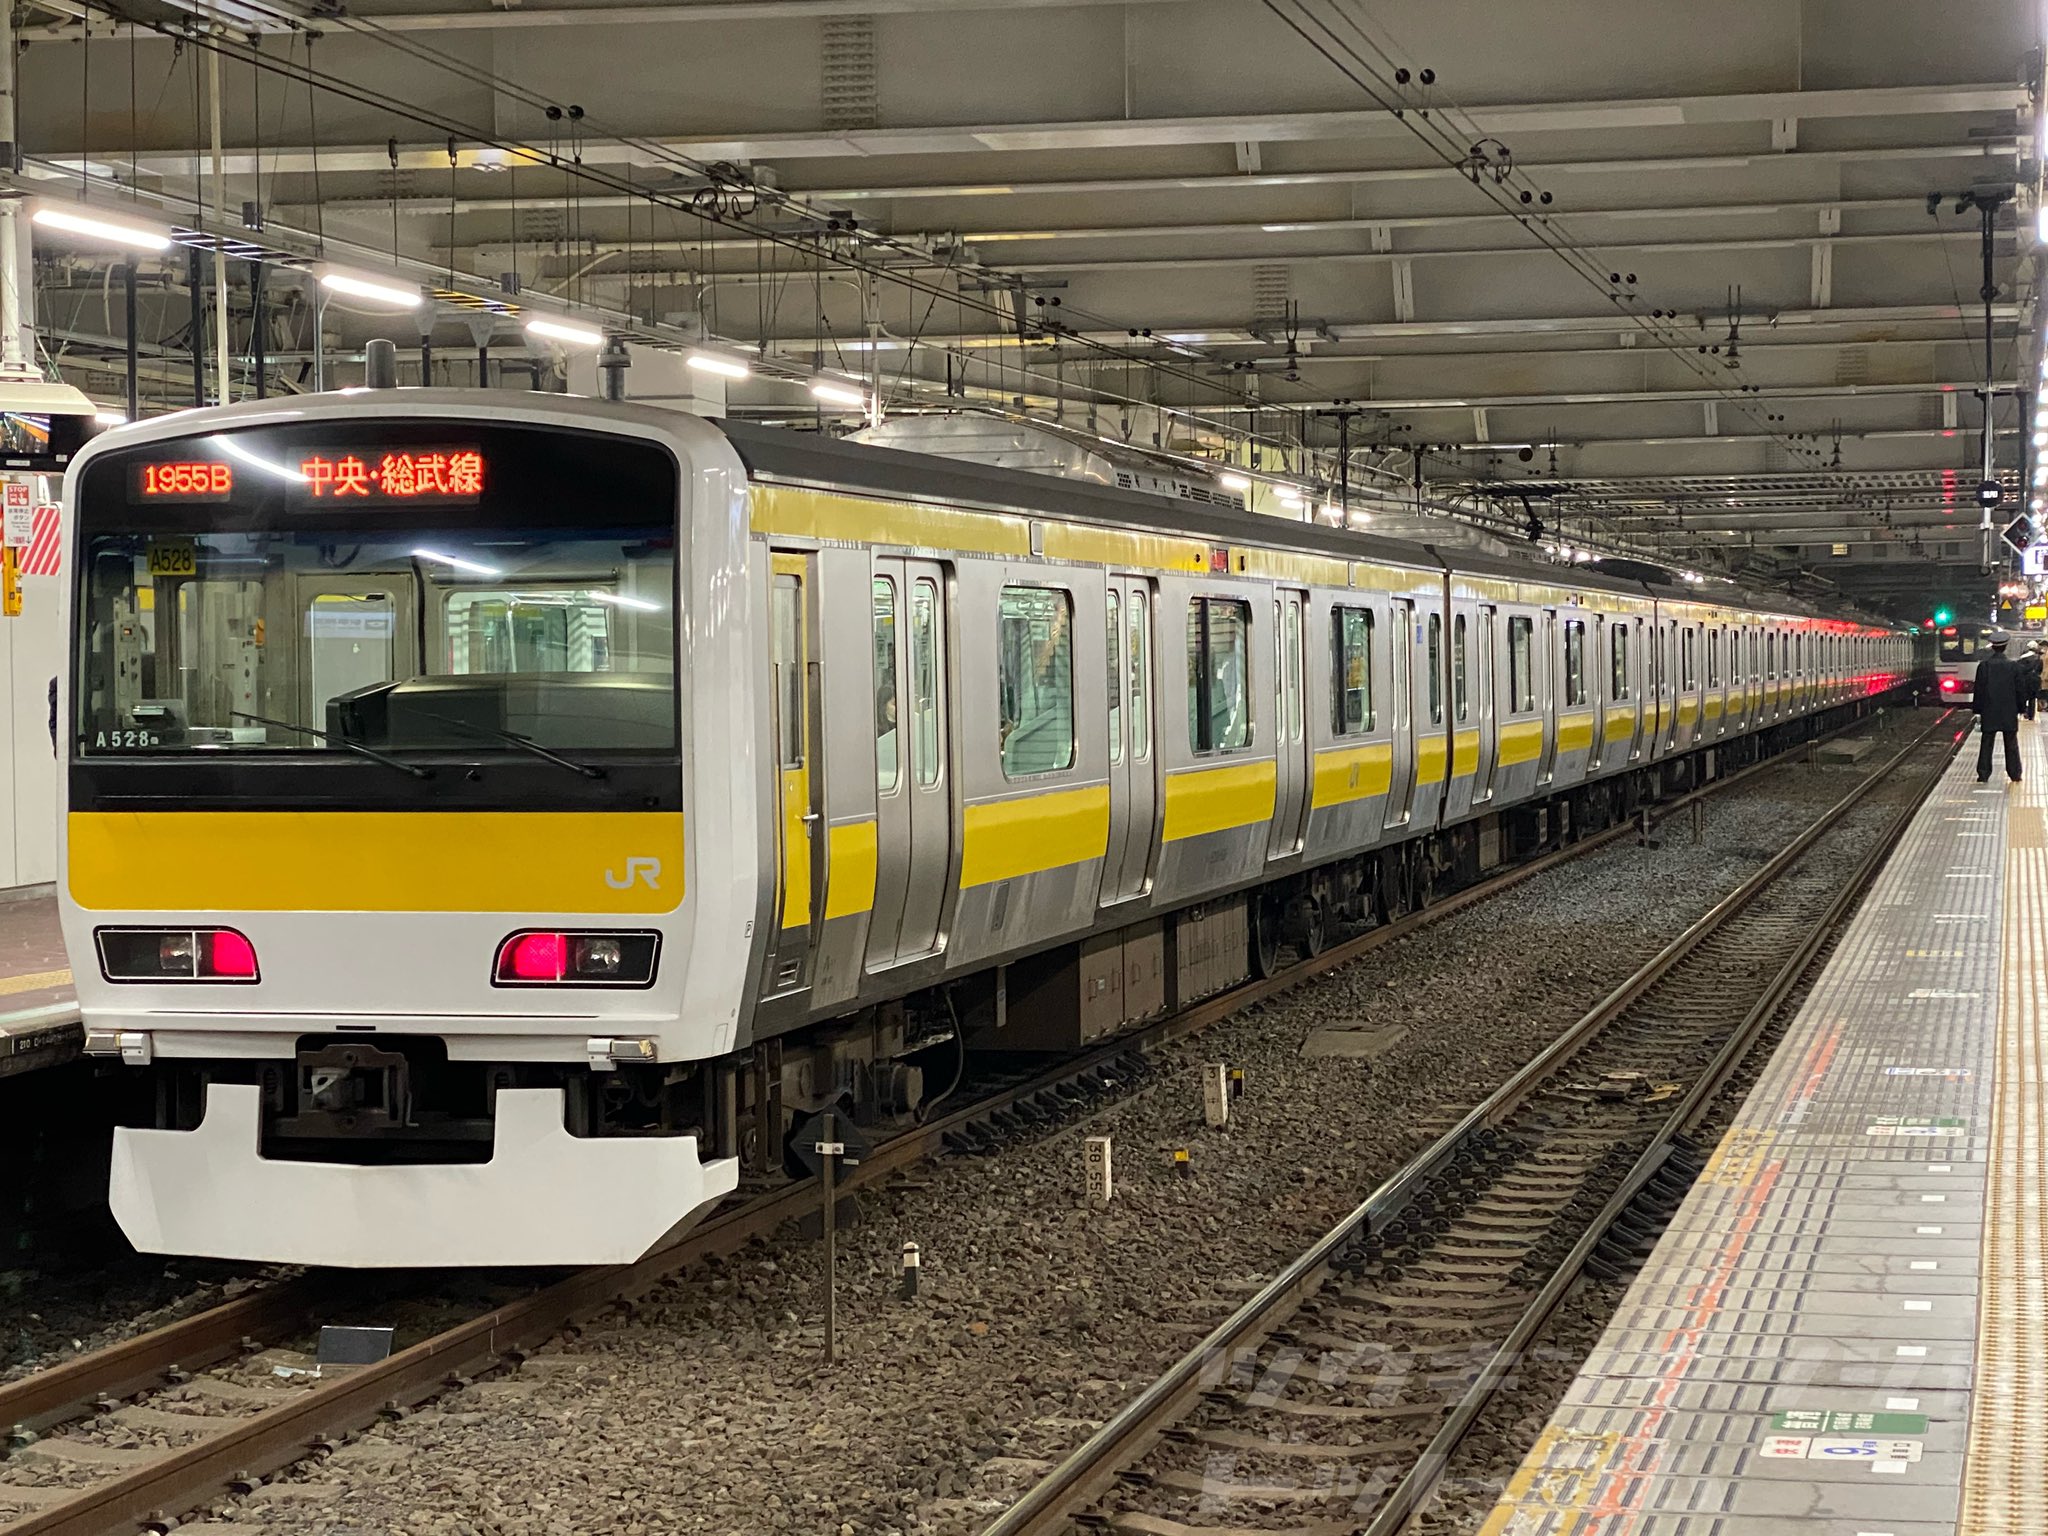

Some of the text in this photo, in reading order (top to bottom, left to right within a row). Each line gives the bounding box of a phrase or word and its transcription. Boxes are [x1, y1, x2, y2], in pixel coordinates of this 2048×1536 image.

[145, 463, 231, 494] 1955B
[301, 452, 483, 497] 中央・総武線
[150, 549, 193, 572] A528
[605, 856, 661, 890] JR
